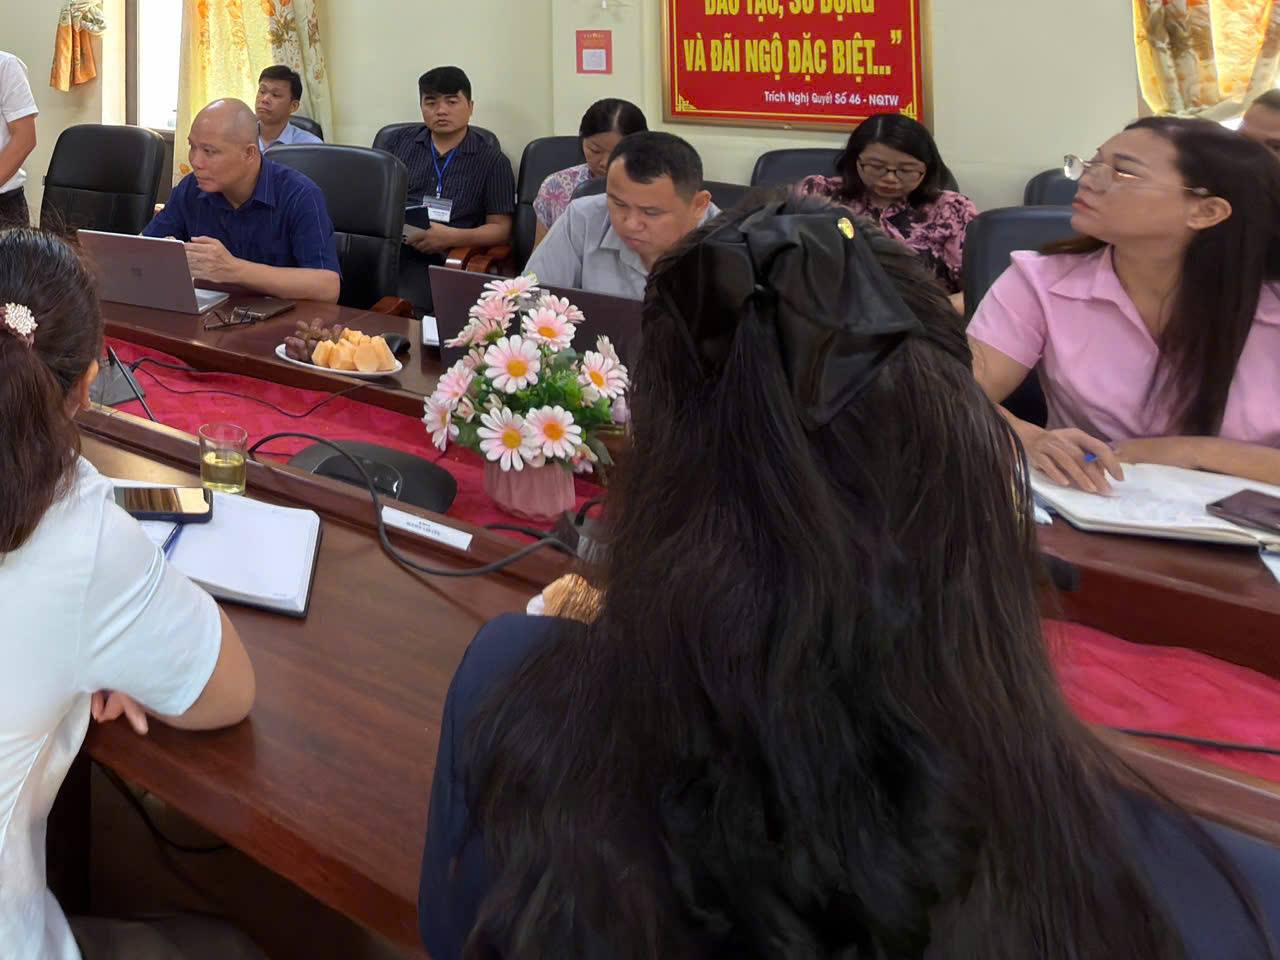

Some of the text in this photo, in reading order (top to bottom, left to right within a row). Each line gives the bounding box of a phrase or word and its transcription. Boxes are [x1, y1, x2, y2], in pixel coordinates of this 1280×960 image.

[683, 32, 707, 72] VÀ
[710, 32, 740, 72] ĐÃI
[745, 32, 783, 81] NGỘ
[788, 32, 826, 81] ĐẶC
[764, 90, 786, 102] Trích
[788, 92, 809, 106] Nghị
[811, 92, 833, 106] Quyết
[834, 91, 847, 104] Số
[849, 95, 861, 105] 46
[869, 94, 899, 106] NQTW
